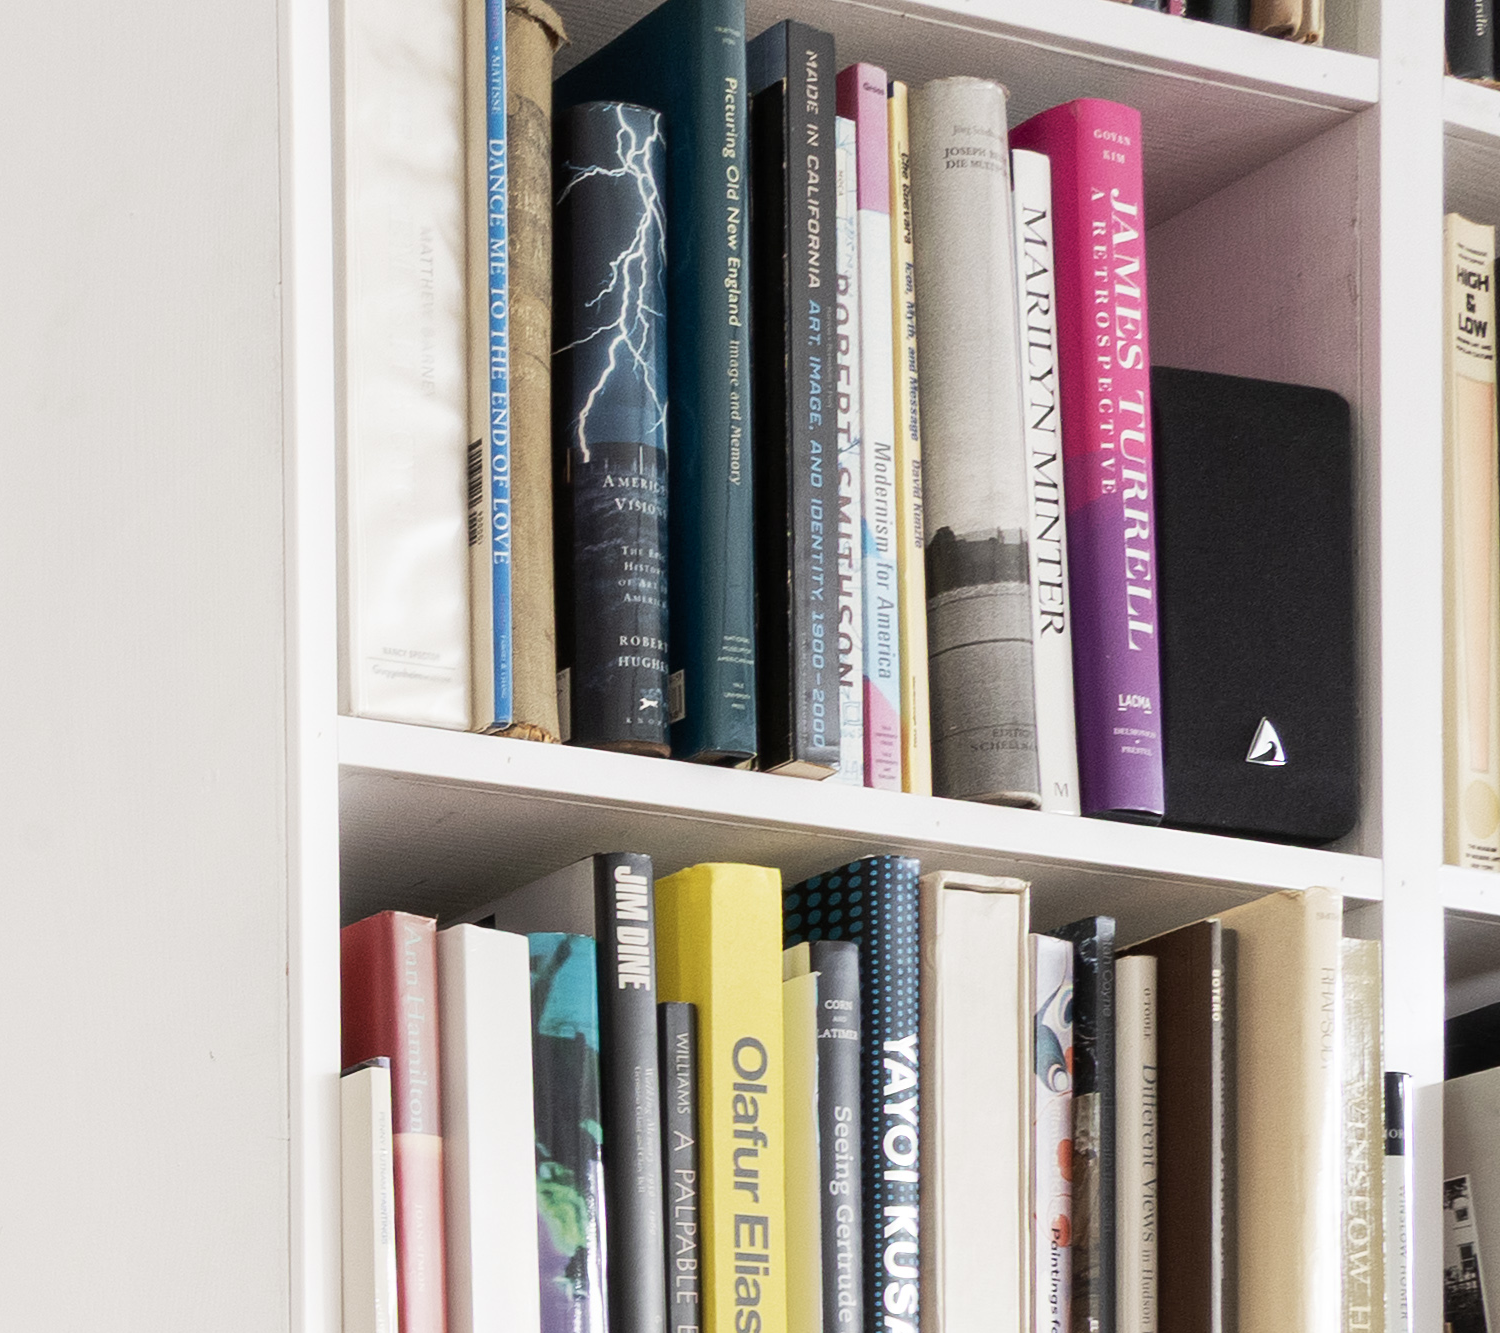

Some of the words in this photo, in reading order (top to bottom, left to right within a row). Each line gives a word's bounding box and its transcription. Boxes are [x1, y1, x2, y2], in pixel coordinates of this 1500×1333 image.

[804, 49, 819, 114] MADE
[804, 122, 819, 148] IN
[804, 156, 821, 289] CALIFORNIA
[1110, 186, 1142, 371] JAMES
[1020, 207, 1060, 434] MARILYN
[1032, 451, 1069, 641] MINTER
[1116, 388, 1157, 652] TURRELL
[613, 866, 634, 920] JIM
[615, 927, 651, 991] DINE
[729, 1034, 771, 1201] Olafur
[880, 1033, 918, 1184] YAYOI
